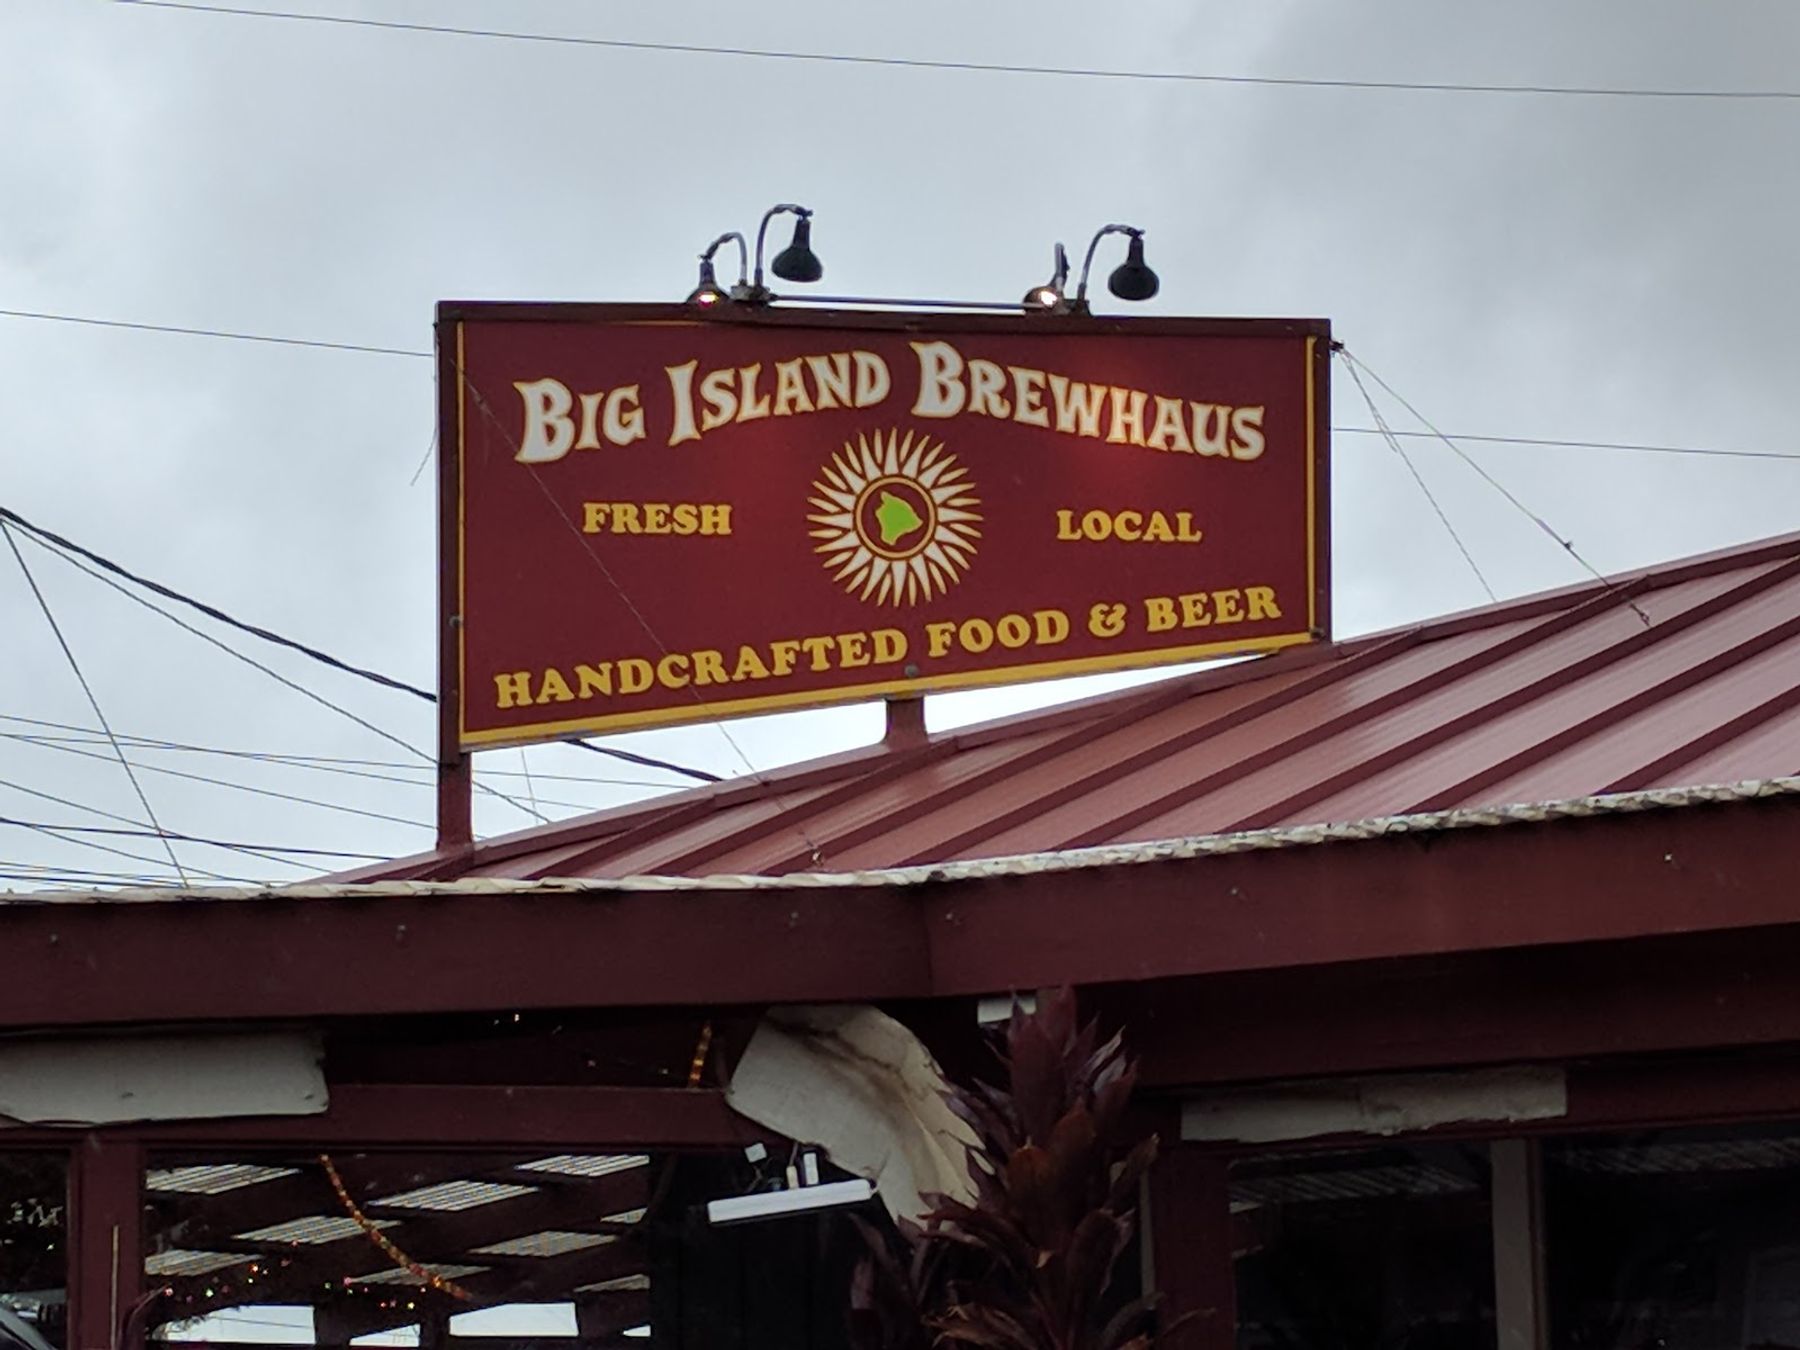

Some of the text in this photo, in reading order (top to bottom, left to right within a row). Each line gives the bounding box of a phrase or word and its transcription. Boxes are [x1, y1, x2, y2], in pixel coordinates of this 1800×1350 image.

[513, 340, 1266, 464] BIG ISLAND BREWHAUS
[583, 502, 733, 537] FRESH
[1056, 509, 1203, 543] LOCAL
[494, 585, 1281, 709] HANDCRAFTED FOOD & BEER
